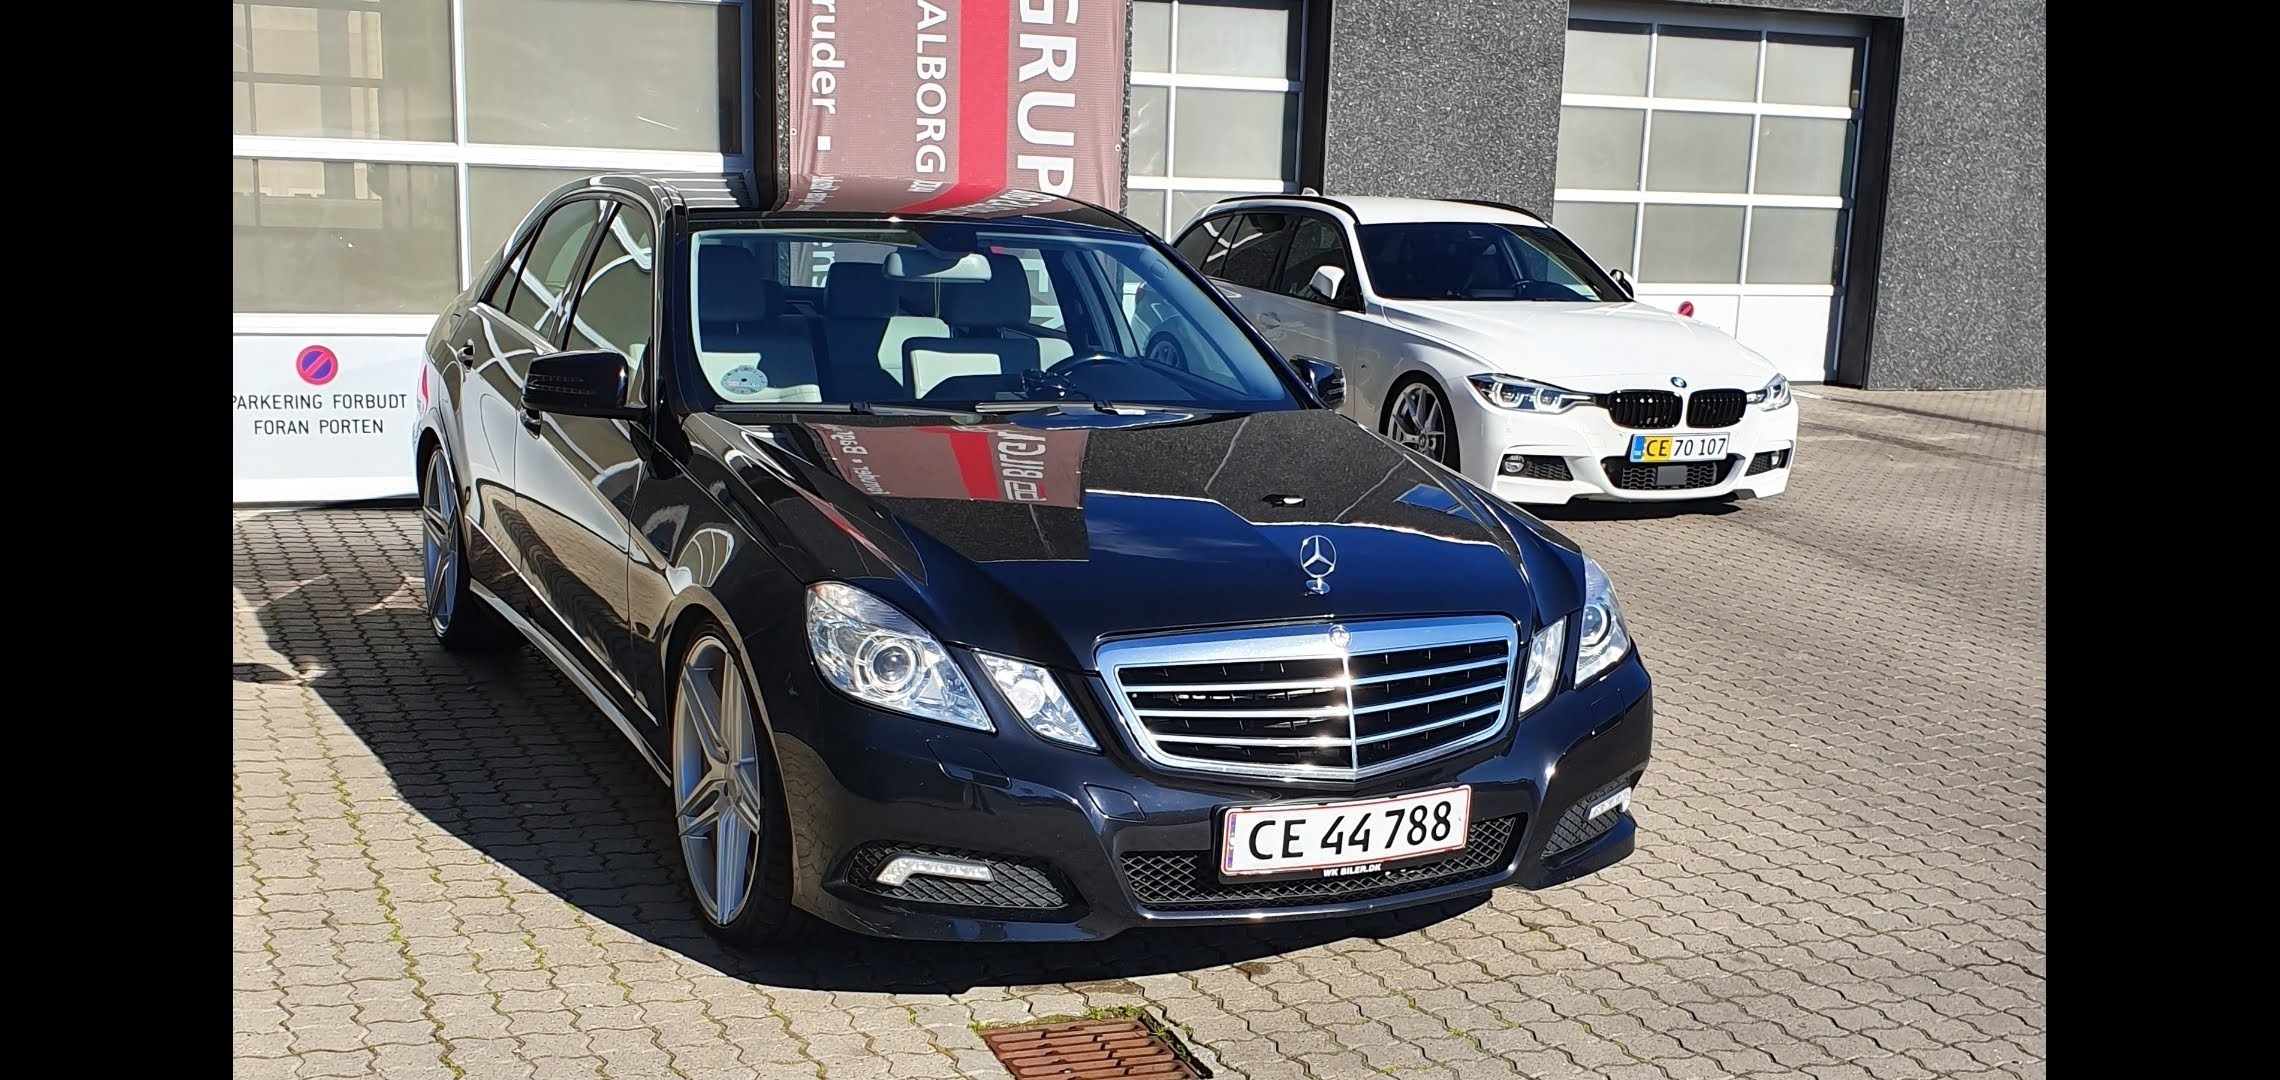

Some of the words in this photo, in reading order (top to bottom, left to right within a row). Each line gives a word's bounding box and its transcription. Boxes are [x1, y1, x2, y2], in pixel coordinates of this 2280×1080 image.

[811, 0, 845, 115] ruder
[915, 0, 947, 174] ALBORG
[333, 394, 407, 409] FORBUDT
[254, 420, 309, 435] FORAN
[320, 419, 384, 434] PORTEN
[1646, 440, 1670, 457] CE
[1673, 439, 1694, 456] 70
[1698, 438, 1727, 456] 107
[1248, 819, 1307, 860] CE
[1320, 812, 1372, 855] 44
[1384, 801, 1452, 849] 788
[1323, 868, 1339, 877] WK
[1340, 863, 1382, 876] BILER.DK
